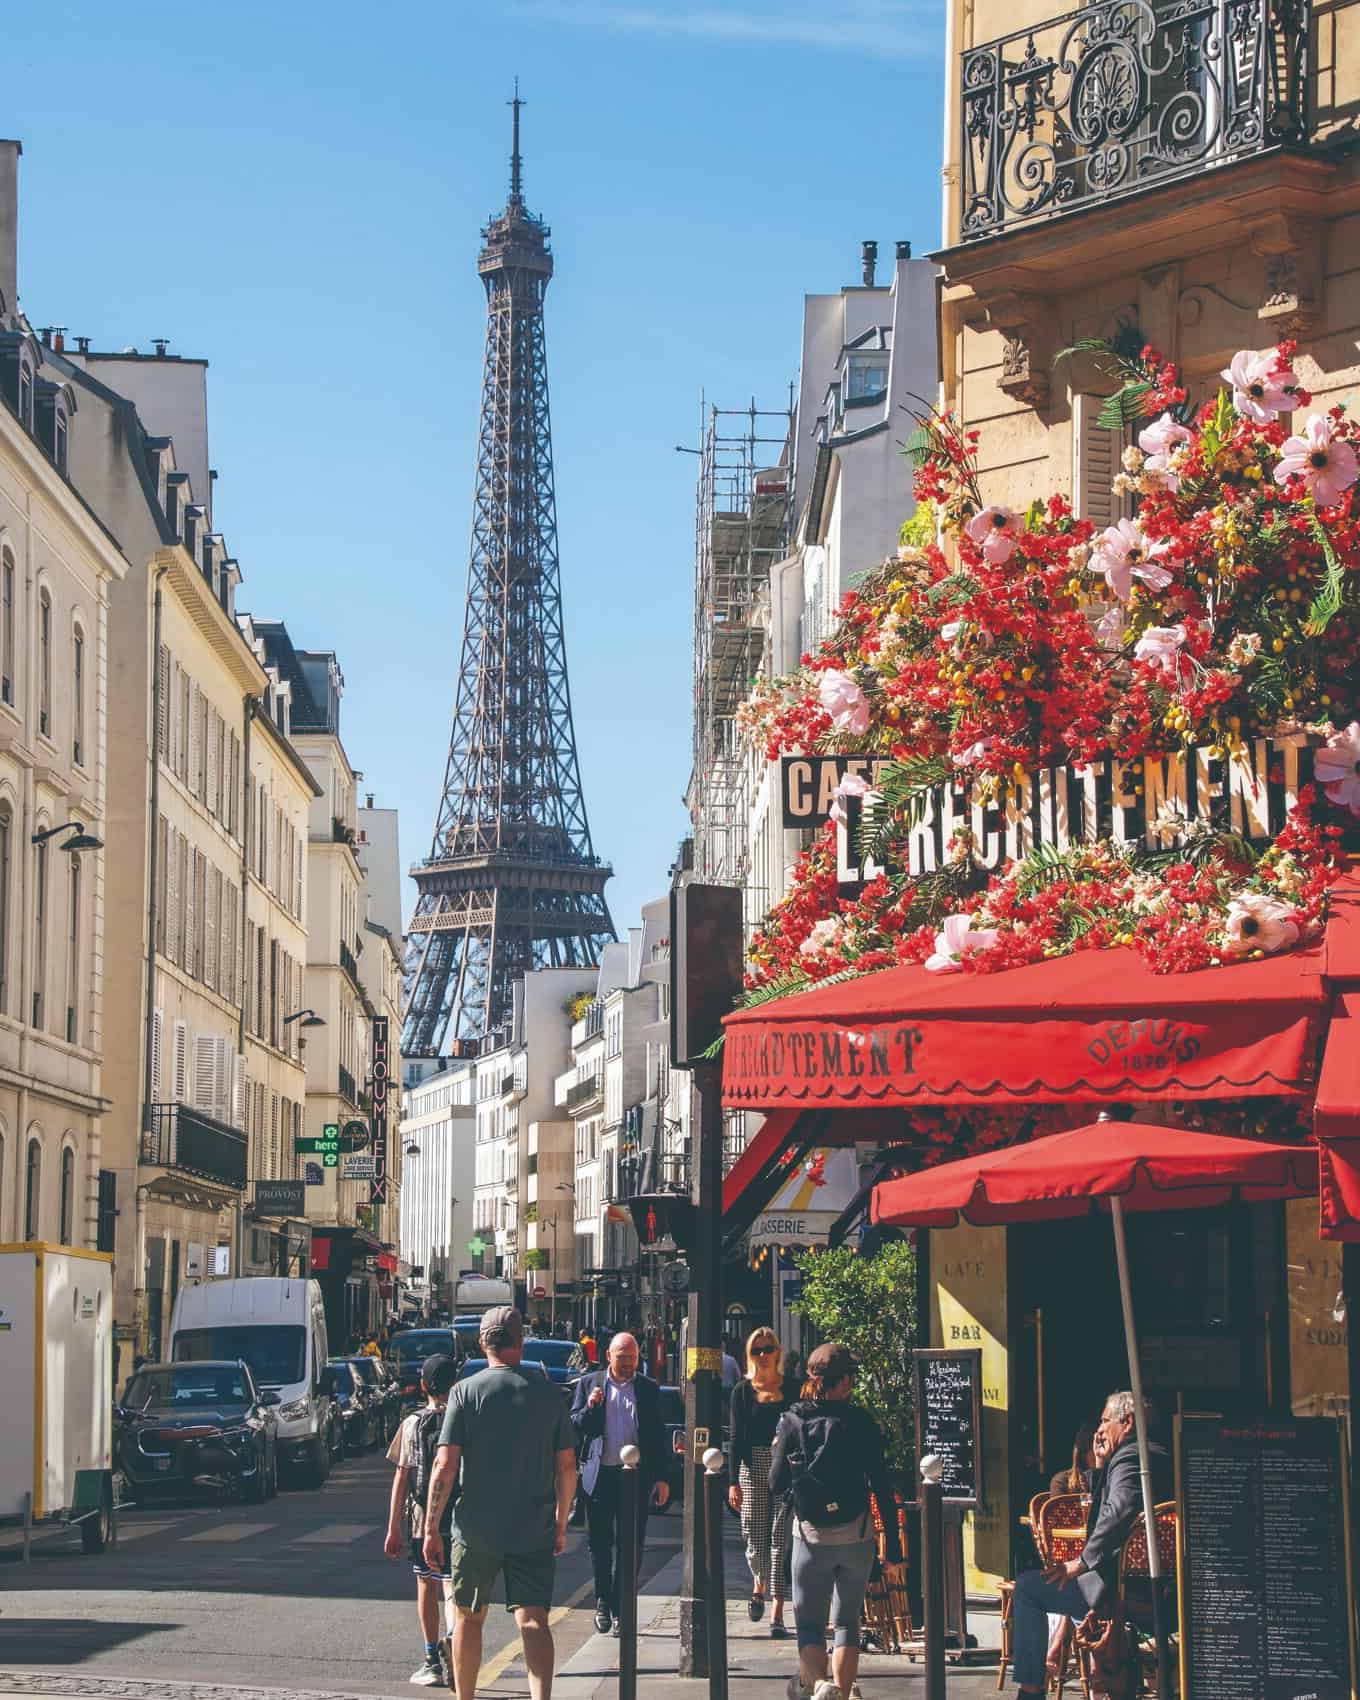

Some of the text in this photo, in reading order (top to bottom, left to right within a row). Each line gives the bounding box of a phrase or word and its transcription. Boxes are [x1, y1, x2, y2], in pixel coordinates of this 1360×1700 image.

[1087, 1019, 1201, 1065] DEPUIS
[372, 1021, 387, 1199] THOUMIEUX
[314, 1140, 339, 1151] here
[951, 1325, 982, 1340] BAR
